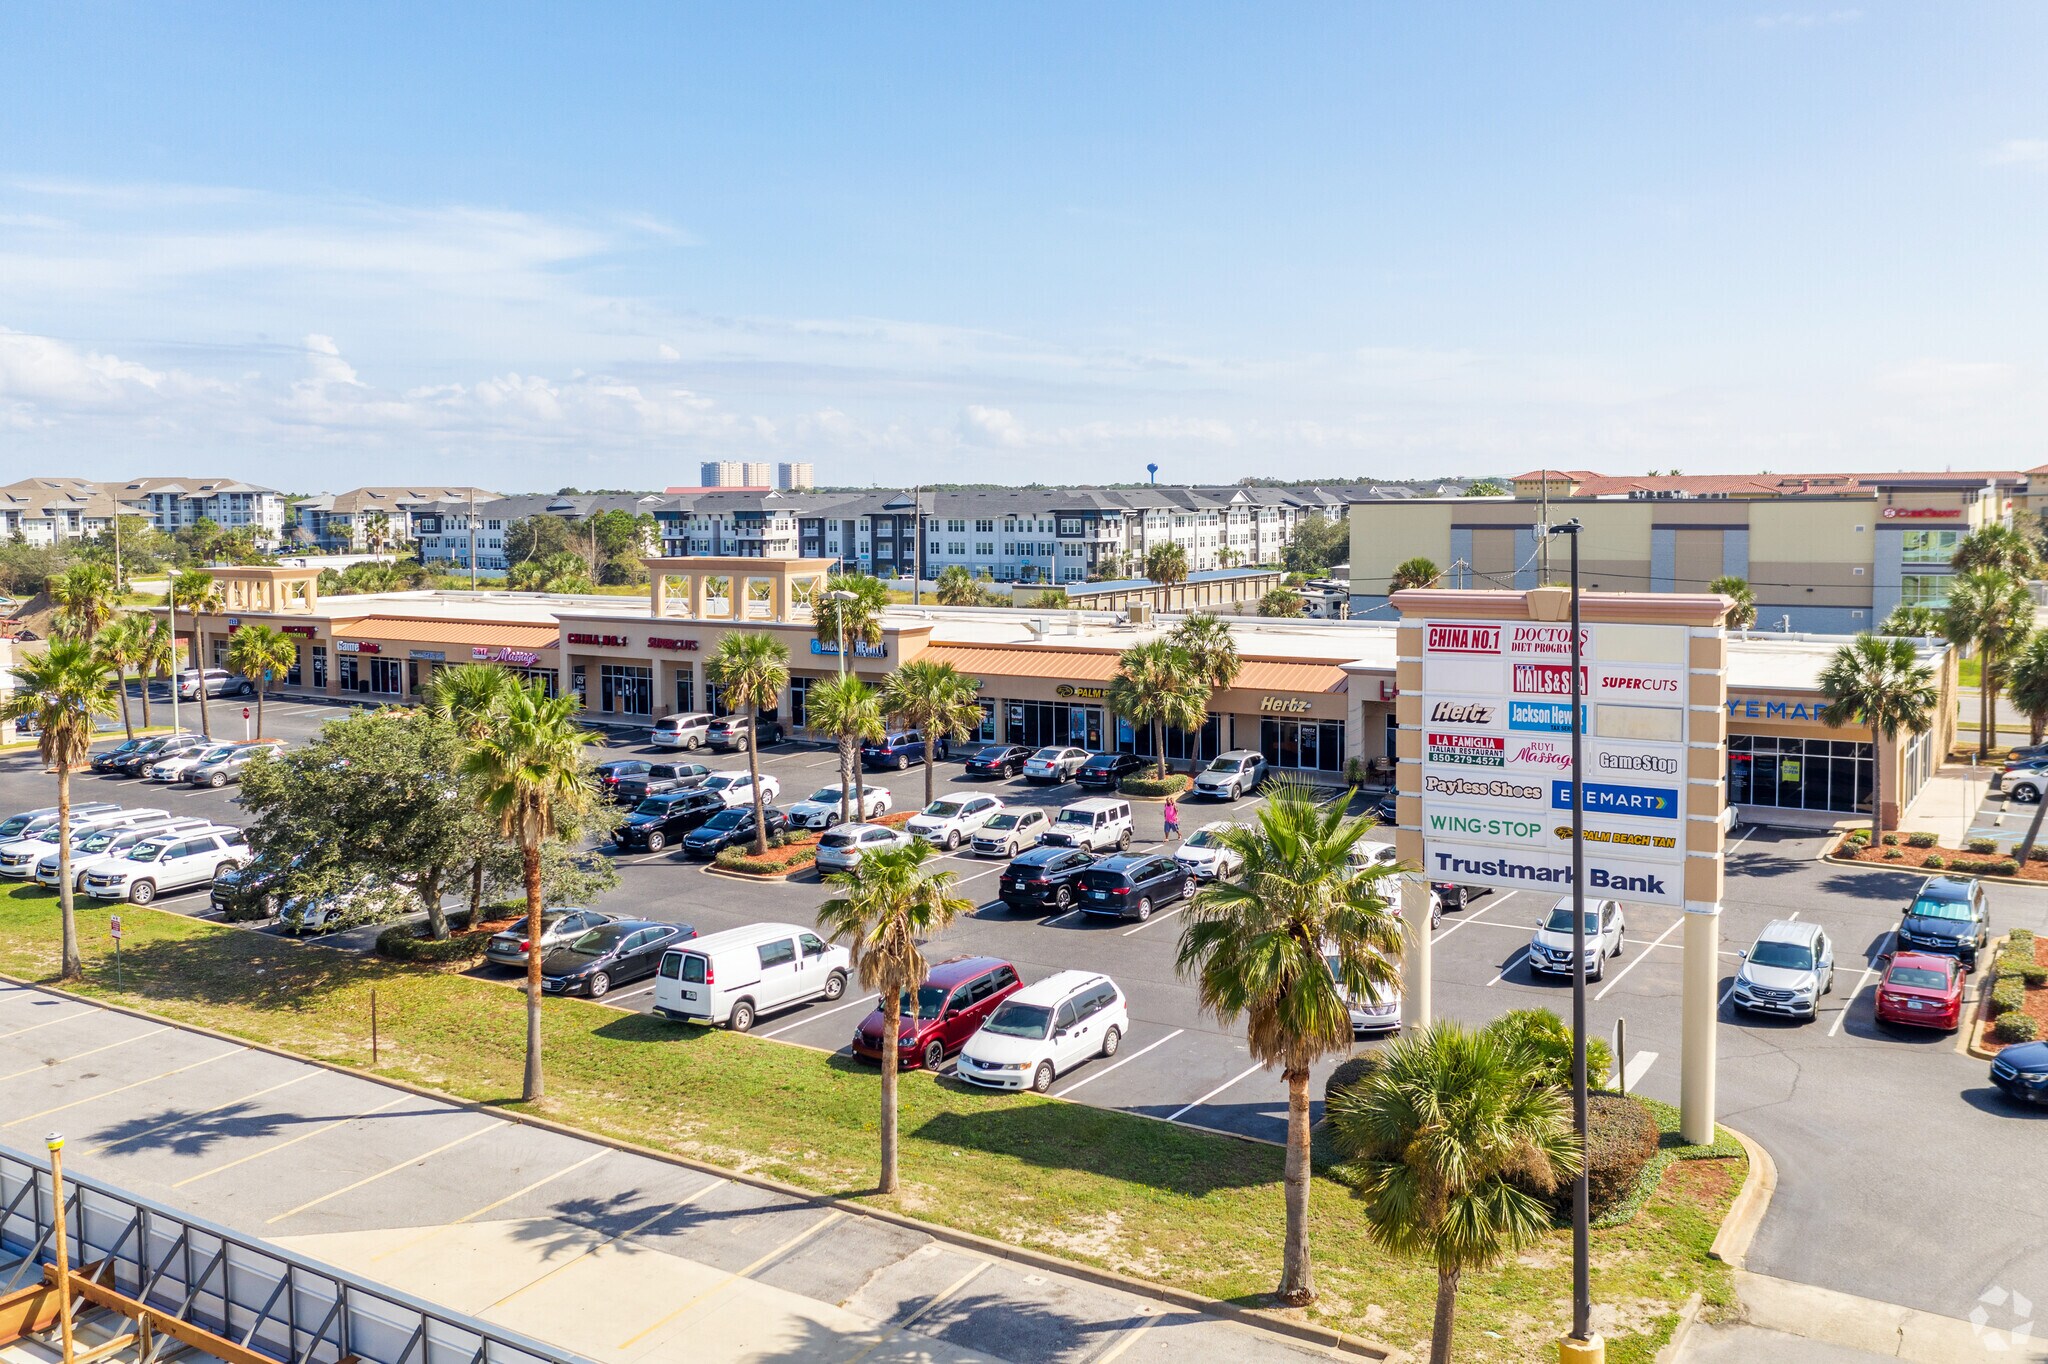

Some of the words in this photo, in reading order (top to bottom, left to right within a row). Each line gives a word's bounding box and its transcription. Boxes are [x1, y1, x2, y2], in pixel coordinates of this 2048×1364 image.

[568, 633, 599, 646] CHINA
[1429, 628, 1468, 648] CHINA
[1471, 630, 1500, 649] NO.1
[1514, 627, 1589, 643] DOCTOS
[648, 637, 699, 651] SUPERCUTS
[1512, 642, 1532, 653] DIET
[491, 647, 540, 666] Massage
[1077, 687, 1102, 698] PALM
[1602, 677, 1679, 691] SUPERCUTS
[1261, 696, 1307, 713] Hertz
[1431, 702, 1495, 724] Hertz
[1512, 703, 1550, 724] Jackson
[1436, 735, 1449, 746] LA
[1452, 736, 1495, 749] FAMIGLIA
[1531, 742, 1554, 752] RUYI
[1429, 745, 1456, 754] ITALIAN
[1459, 747, 1503, 757] RESTAURANT
[1432, 753, 1501, 766] 850-279-4527
[1506, 747, 1573, 770] Massag
[1600, 752, 1677, 774] GameStop
[1426, 776, 1488, 796] Payless
[1489, 781, 1542, 799] Shoes
[1560, 789, 1654, 809] EEMART
[1582, 830, 1611, 842] PALM
[1612, 833, 1651, 846] BEACH
[1652, 836, 1676, 848] TAN
[1435, 852, 1574, 885] Trustmark
[1590, 868, 1665, 895] Bank
